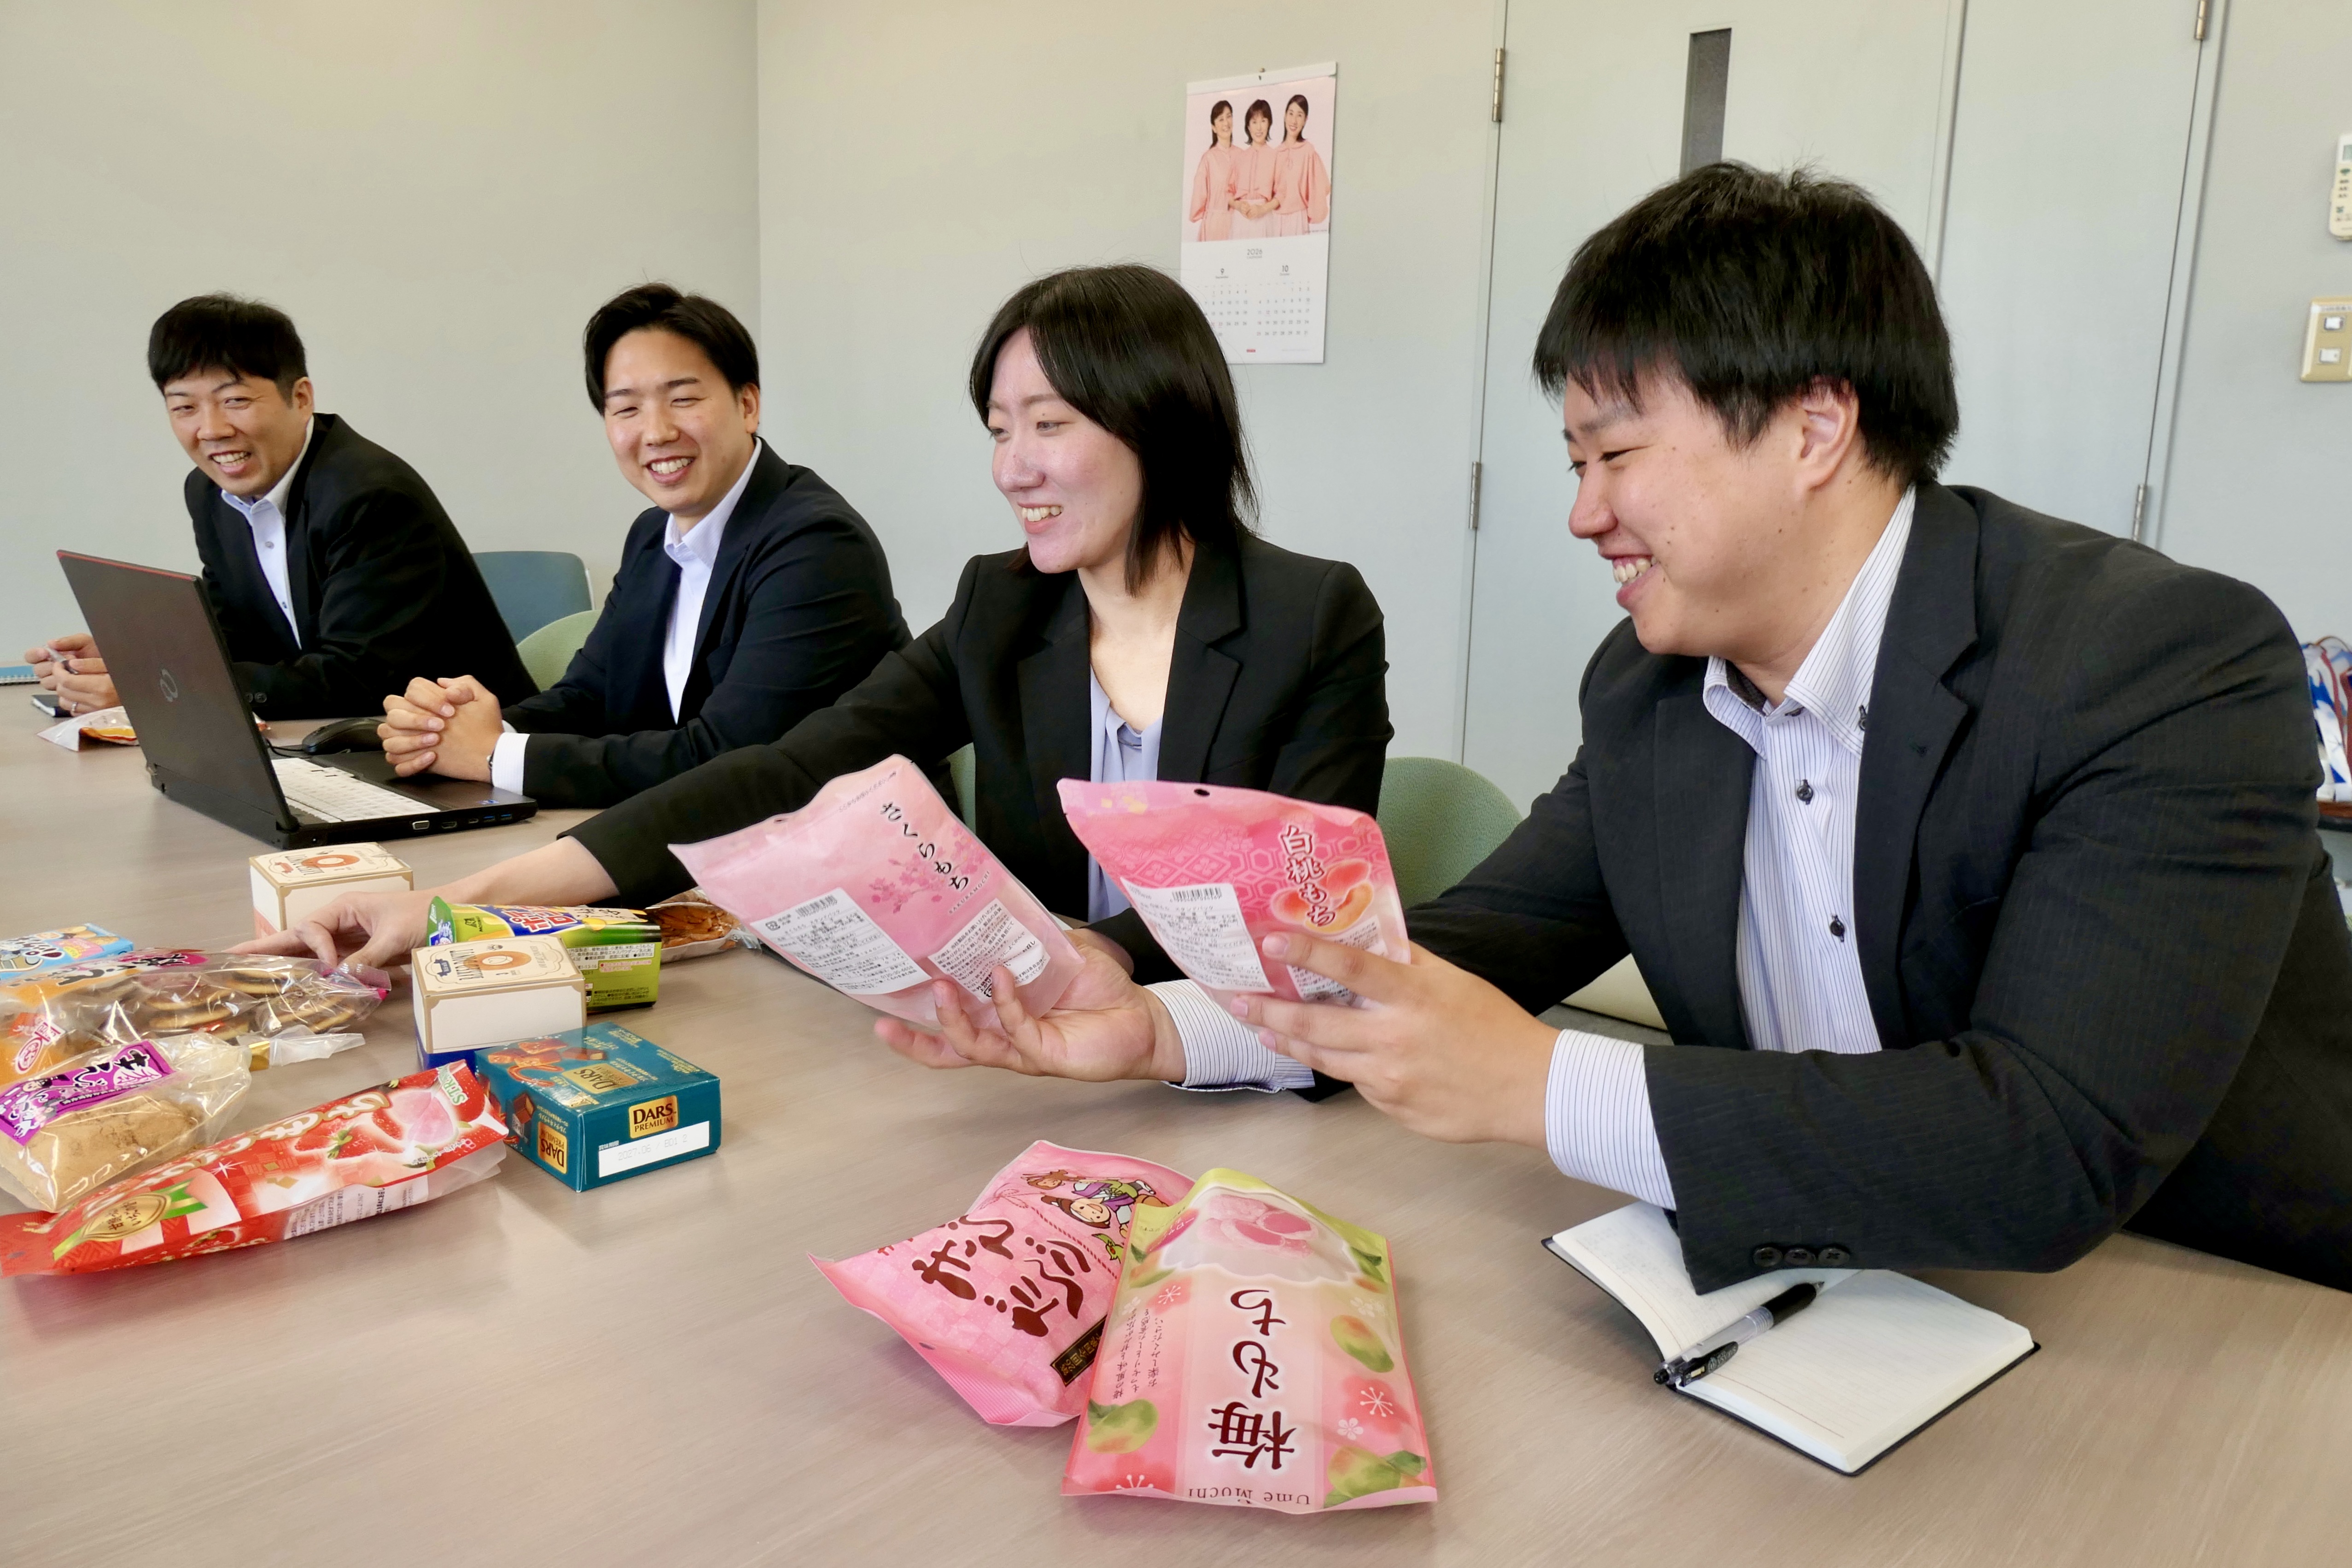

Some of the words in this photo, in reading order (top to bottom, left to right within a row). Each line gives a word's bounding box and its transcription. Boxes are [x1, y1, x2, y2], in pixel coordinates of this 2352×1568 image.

[880, 802, 970, 892] さくらもち
[1279, 824, 1336, 927] 白桃もち
[949, 870, 991, 914] SAKURAMOCHI
[573, 1068, 618, 1090] DARS
[633, 1102, 674, 1125] DARS
[635, 1116, 674, 1132] PREMIUM
[541, 1138, 564, 1167] DARS
[912, 1216, 1015, 1300] きび
[982, 1237, 1092, 1338] だんご
[1147, 1316, 1163, 1387] お楽しみください。
[1207, 1288, 1296, 1470] 梅もち
[1263, 1491, 1309, 1505] Ume
